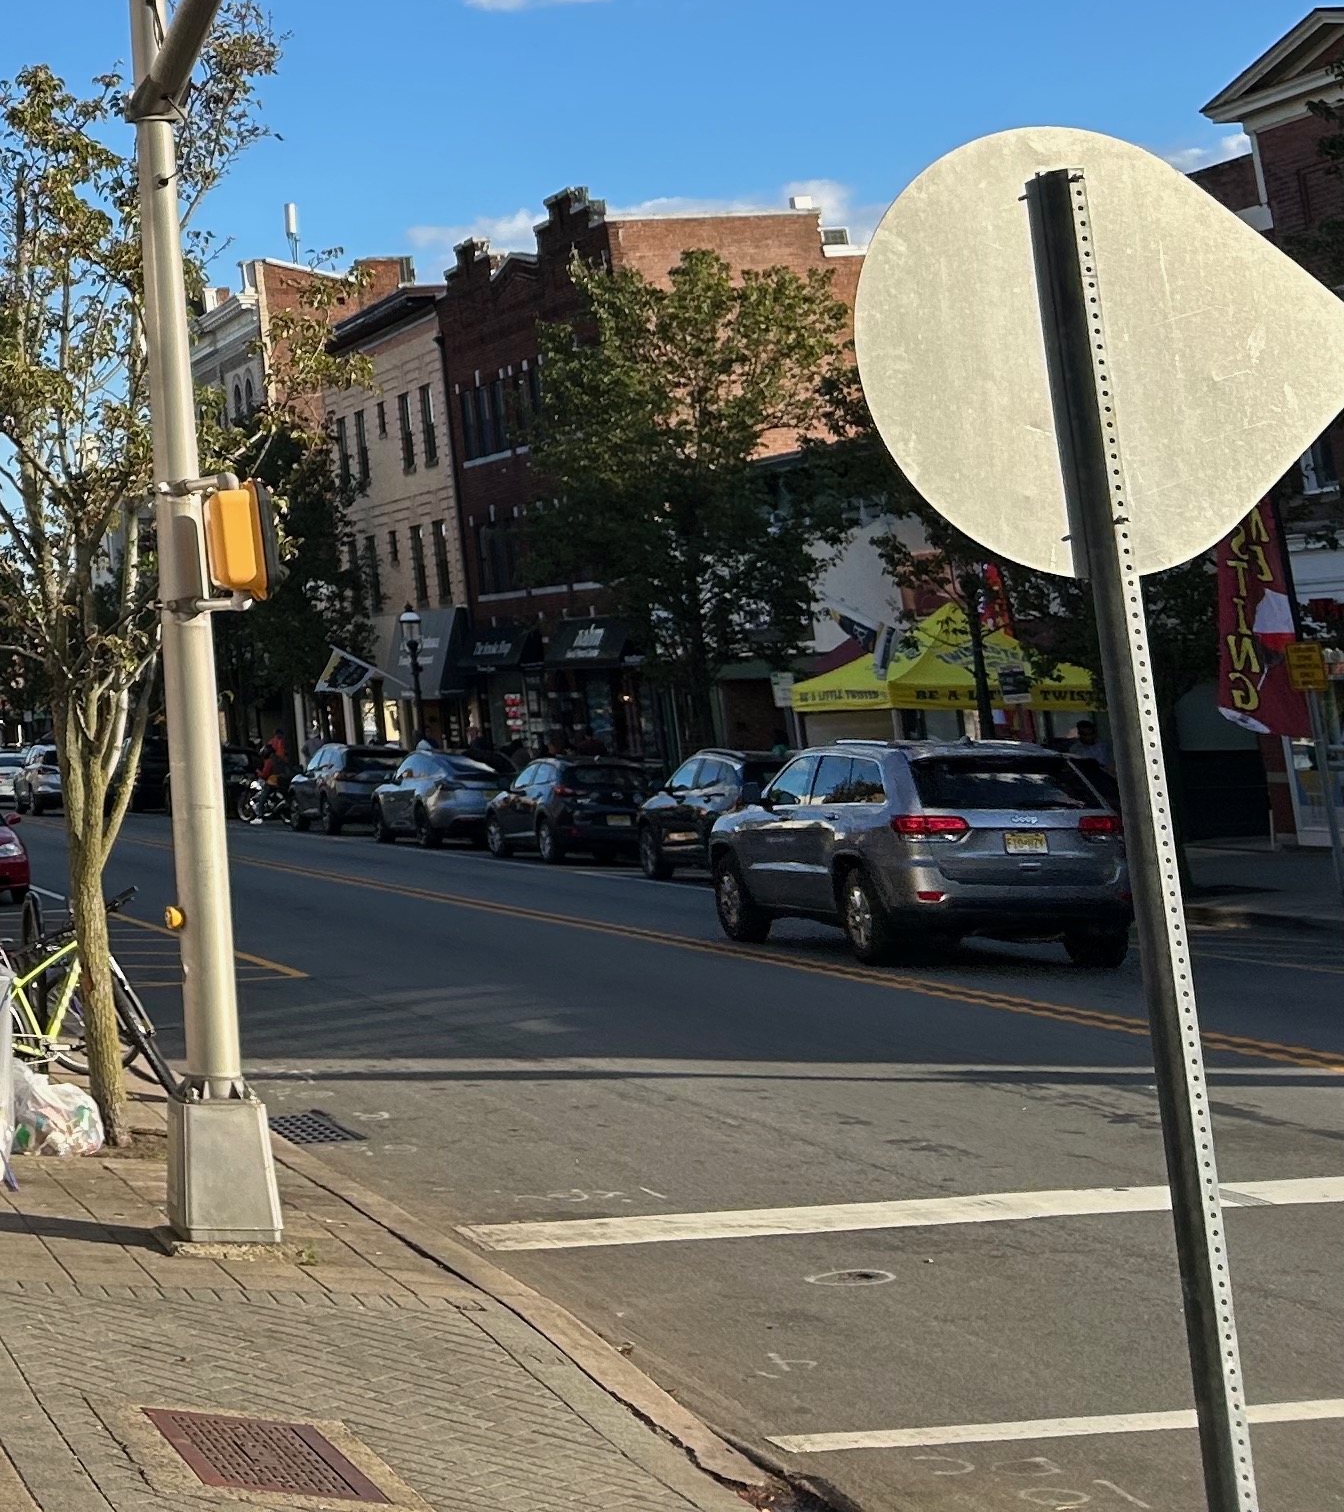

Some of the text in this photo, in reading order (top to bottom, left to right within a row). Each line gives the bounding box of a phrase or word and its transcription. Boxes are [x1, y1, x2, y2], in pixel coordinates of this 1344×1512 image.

[914, 690, 939, 700] BE
[948, 690, 960, 700] A
[1011, 814, 1039, 825] Jeep
